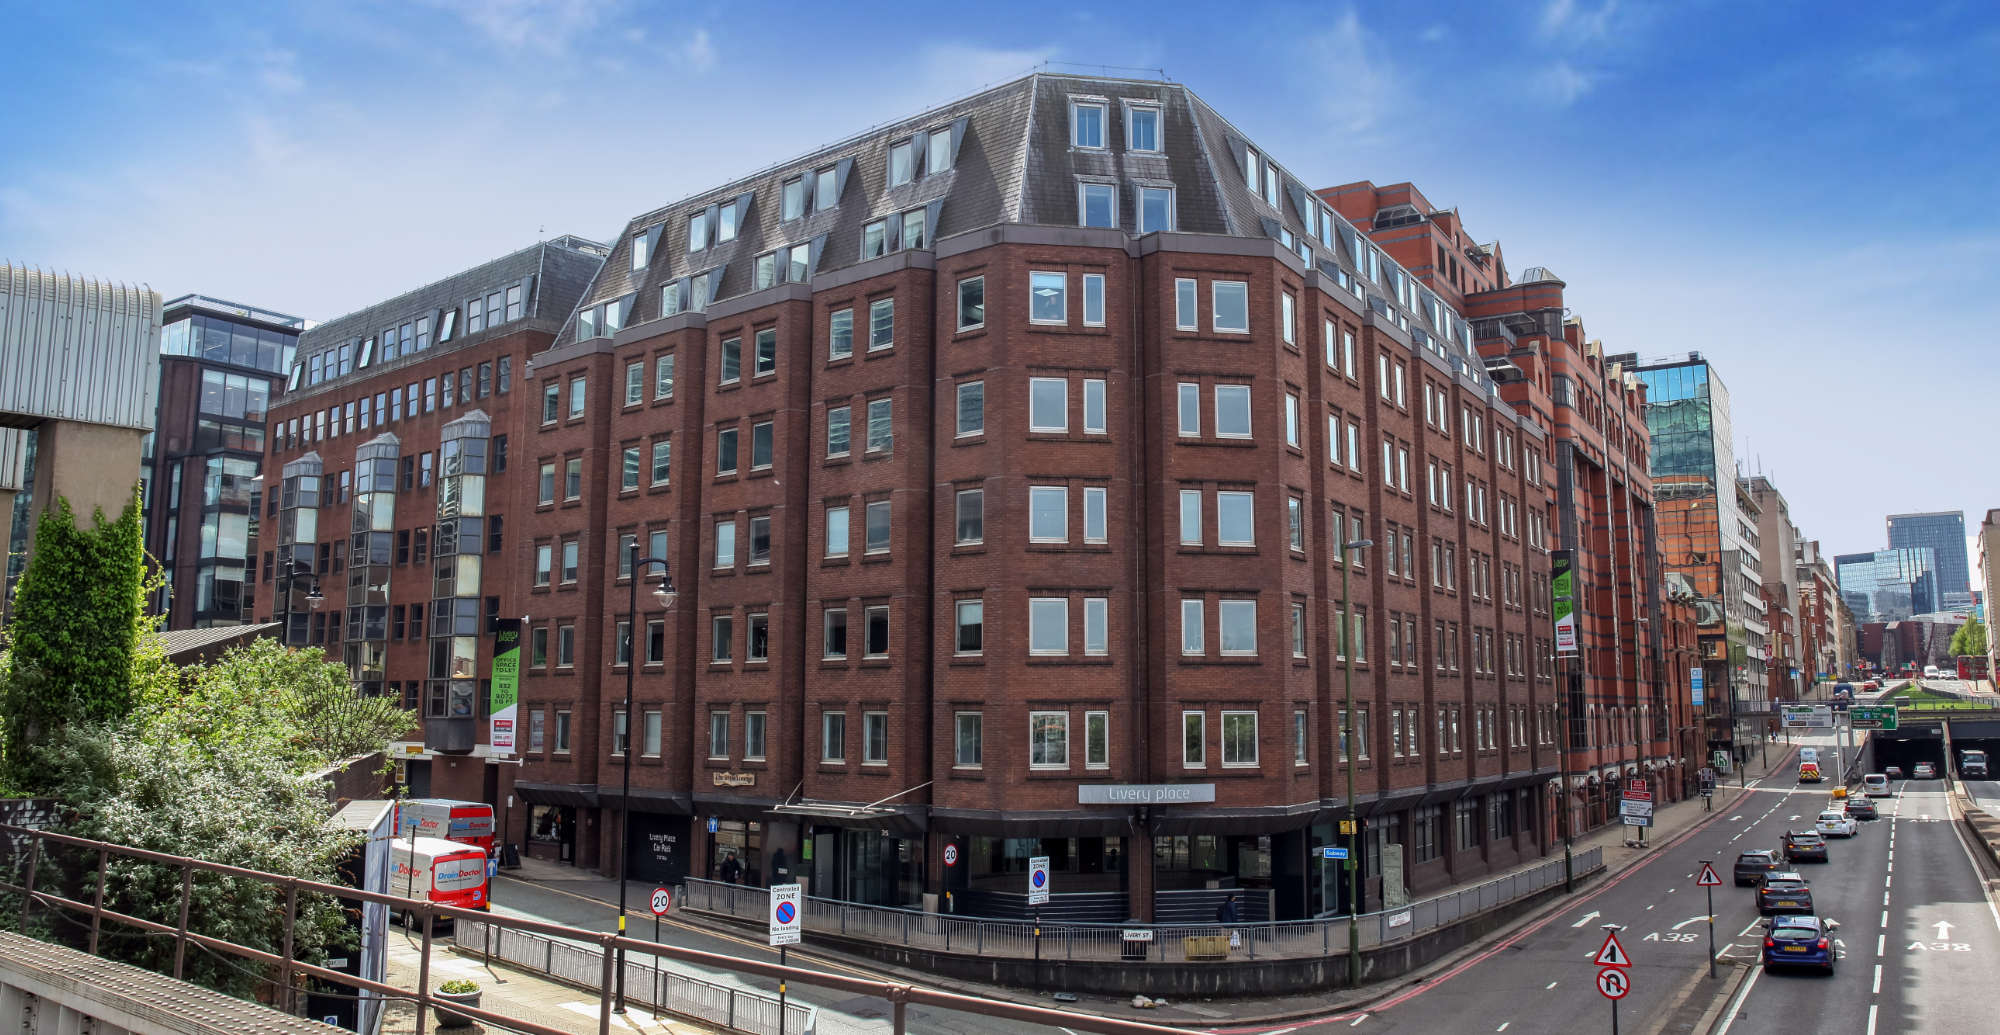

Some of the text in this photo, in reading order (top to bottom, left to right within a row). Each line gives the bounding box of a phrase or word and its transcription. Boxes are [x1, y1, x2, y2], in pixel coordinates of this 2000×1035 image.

[1109, 787, 1190, 802] Livery place
[945, 849, 956, 860] 20
[1327, 849, 1346, 857] Subway
[438, 868, 481, 881] DrainDoctor
[654, 895, 668, 908] 20
[776, 892, 796, 900] ZONE
[1642, 932, 1699, 943] A38
[1906, 941, 1972, 952] A38
